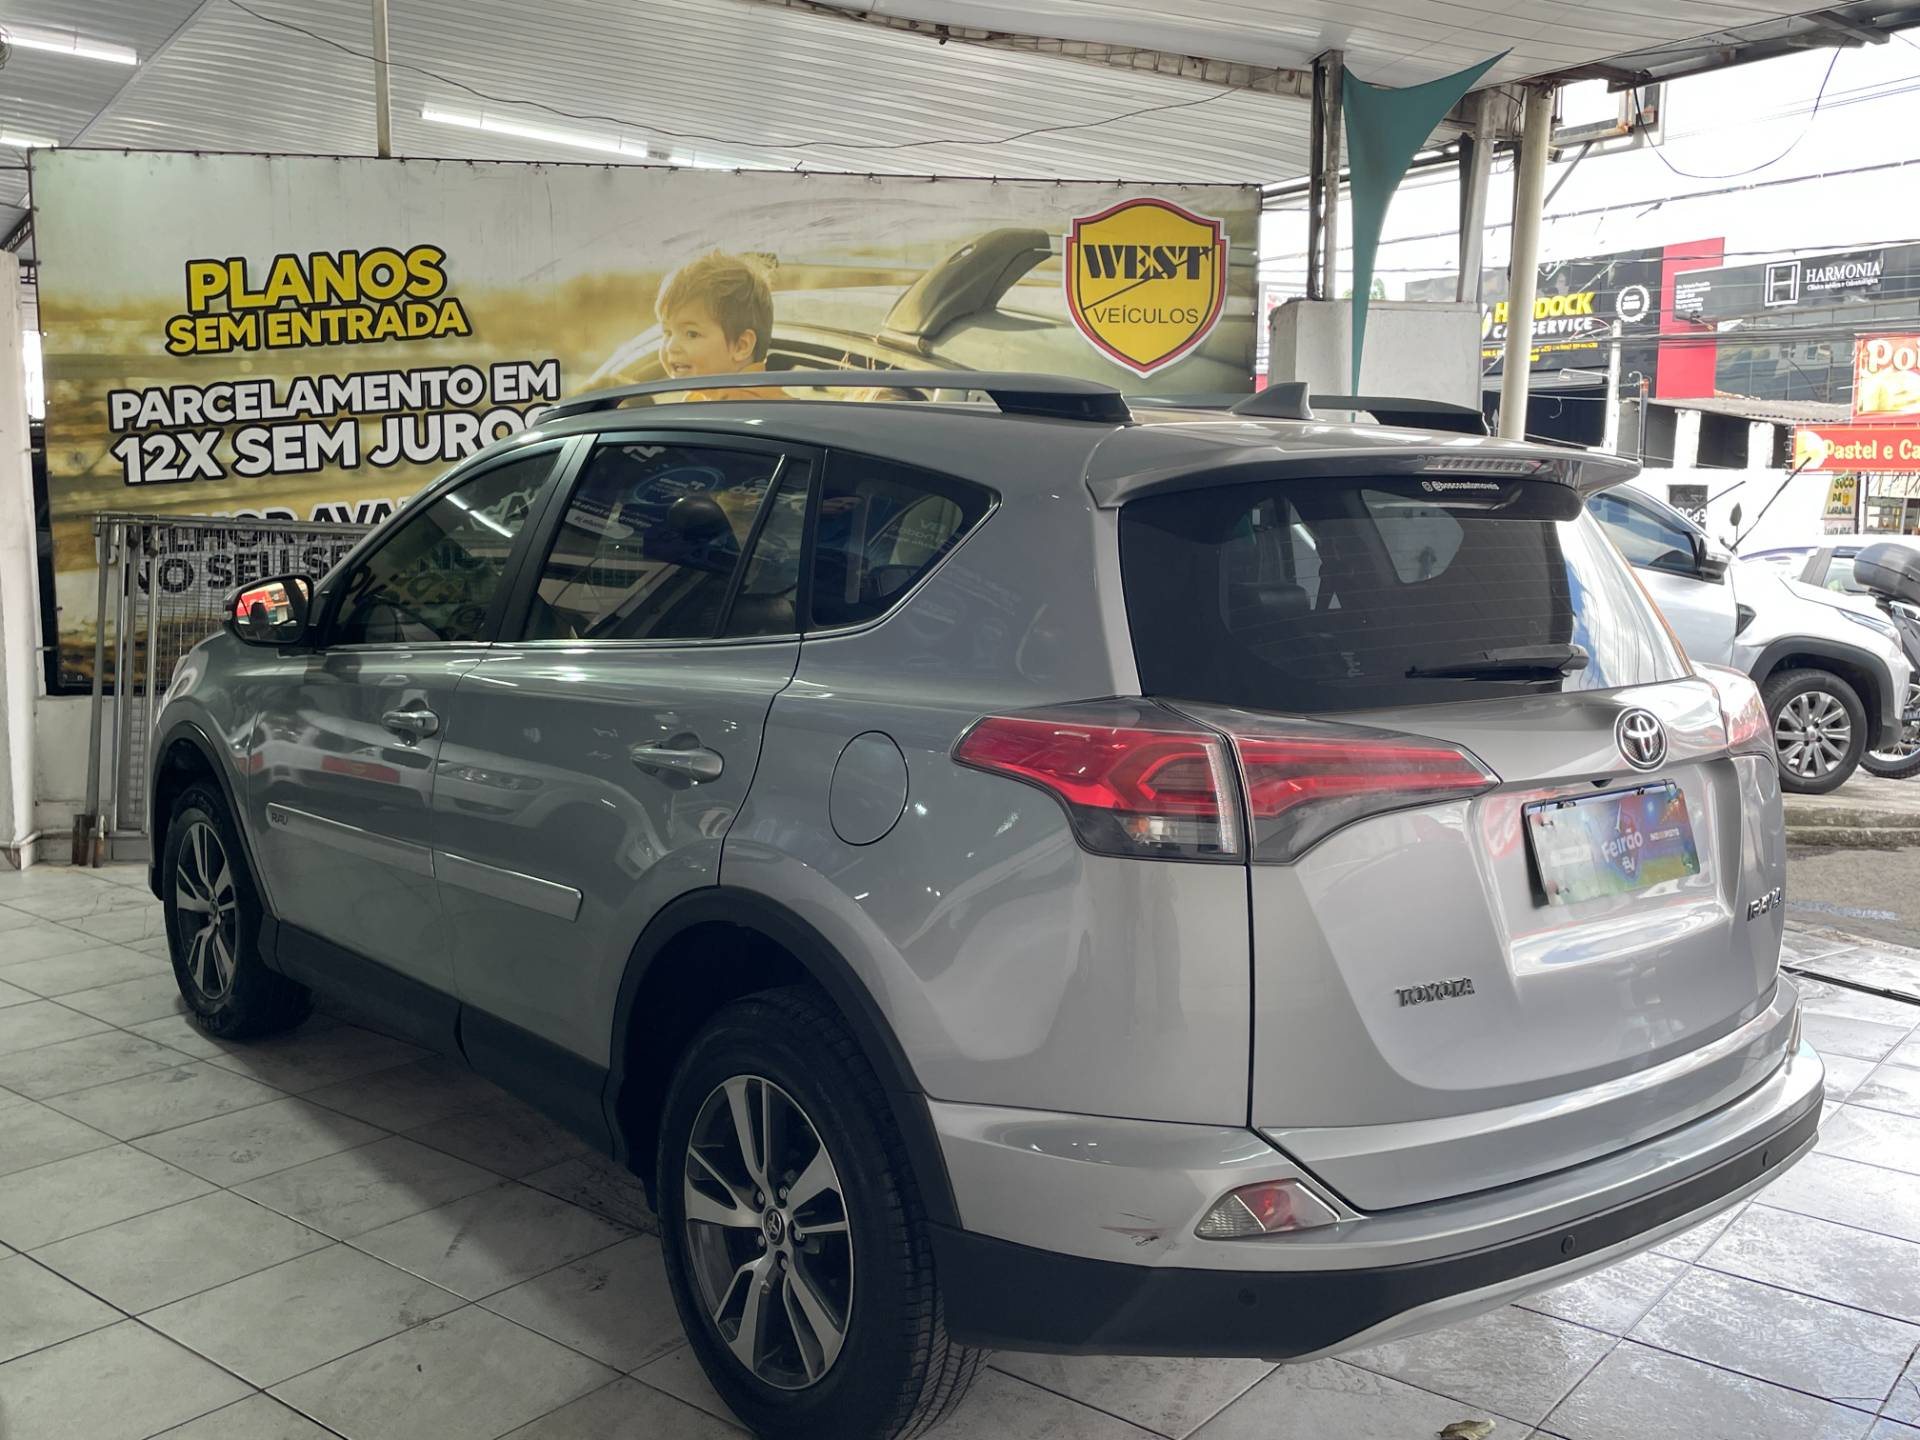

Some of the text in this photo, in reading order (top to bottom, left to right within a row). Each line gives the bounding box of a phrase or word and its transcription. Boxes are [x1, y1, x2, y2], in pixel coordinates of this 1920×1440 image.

[186, 245, 447, 312] PLANOS
[1082, 244, 1212, 280] WEST
[1806, 261, 1881, 284] HARMONIA
[1093, 304, 1199, 324] VEÍCULOS
[1494, 292, 1594, 323] HDOCK
[167, 300, 472, 355] SEM ENTRADA
[1867, 337, 1920, 374] Po
[109, 359, 560, 431] PARCELAMENTO EM
[110, 428, 226, 486] 12X
[231, 417, 360, 477] SEM
[1824, 438, 1878, 460] Pastel
[1883, 444, 1894, 460] e
[124, 556, 194, 596] NO
[1394, 977, 1476, 1008] TOYOTA
